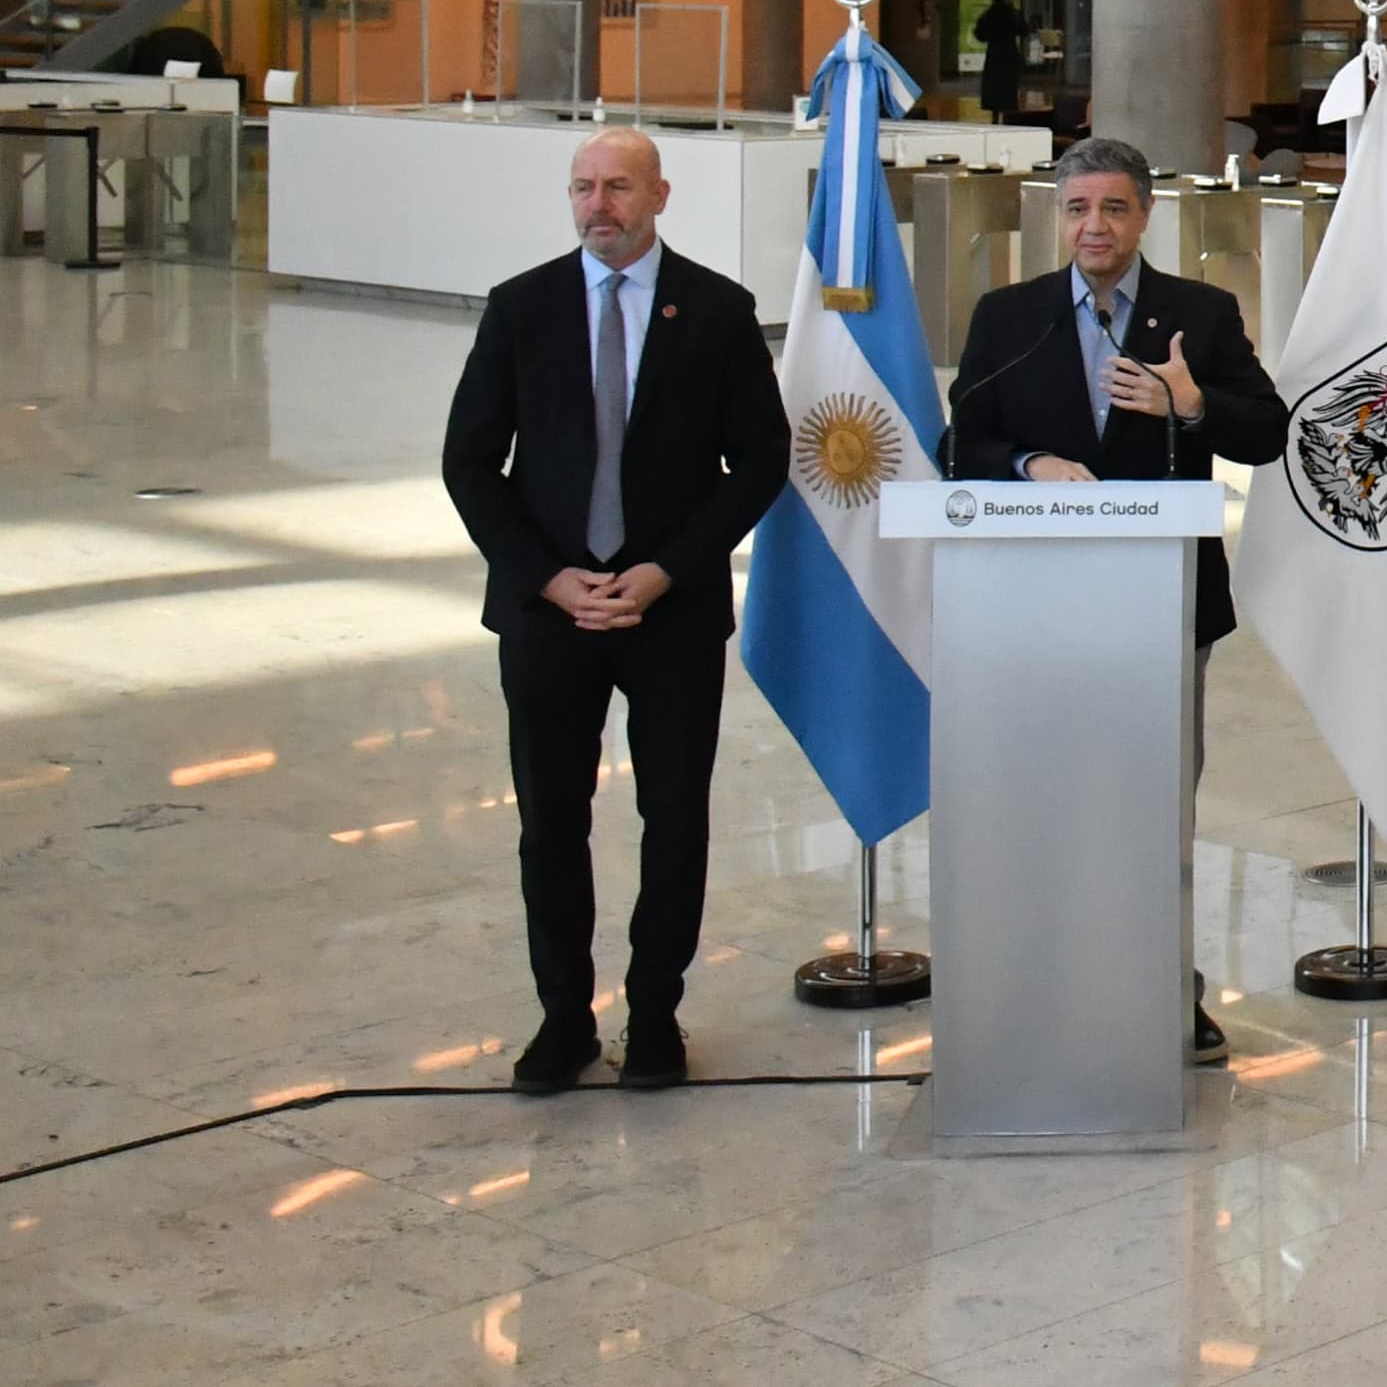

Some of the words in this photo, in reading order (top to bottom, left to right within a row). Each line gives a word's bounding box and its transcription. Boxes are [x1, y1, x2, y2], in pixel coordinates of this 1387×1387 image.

[984, 502, 1044, 516] Buenos
[1049, 502, 1094, 516] Aires
[1100, 502, 1159, 516] Ciudad
